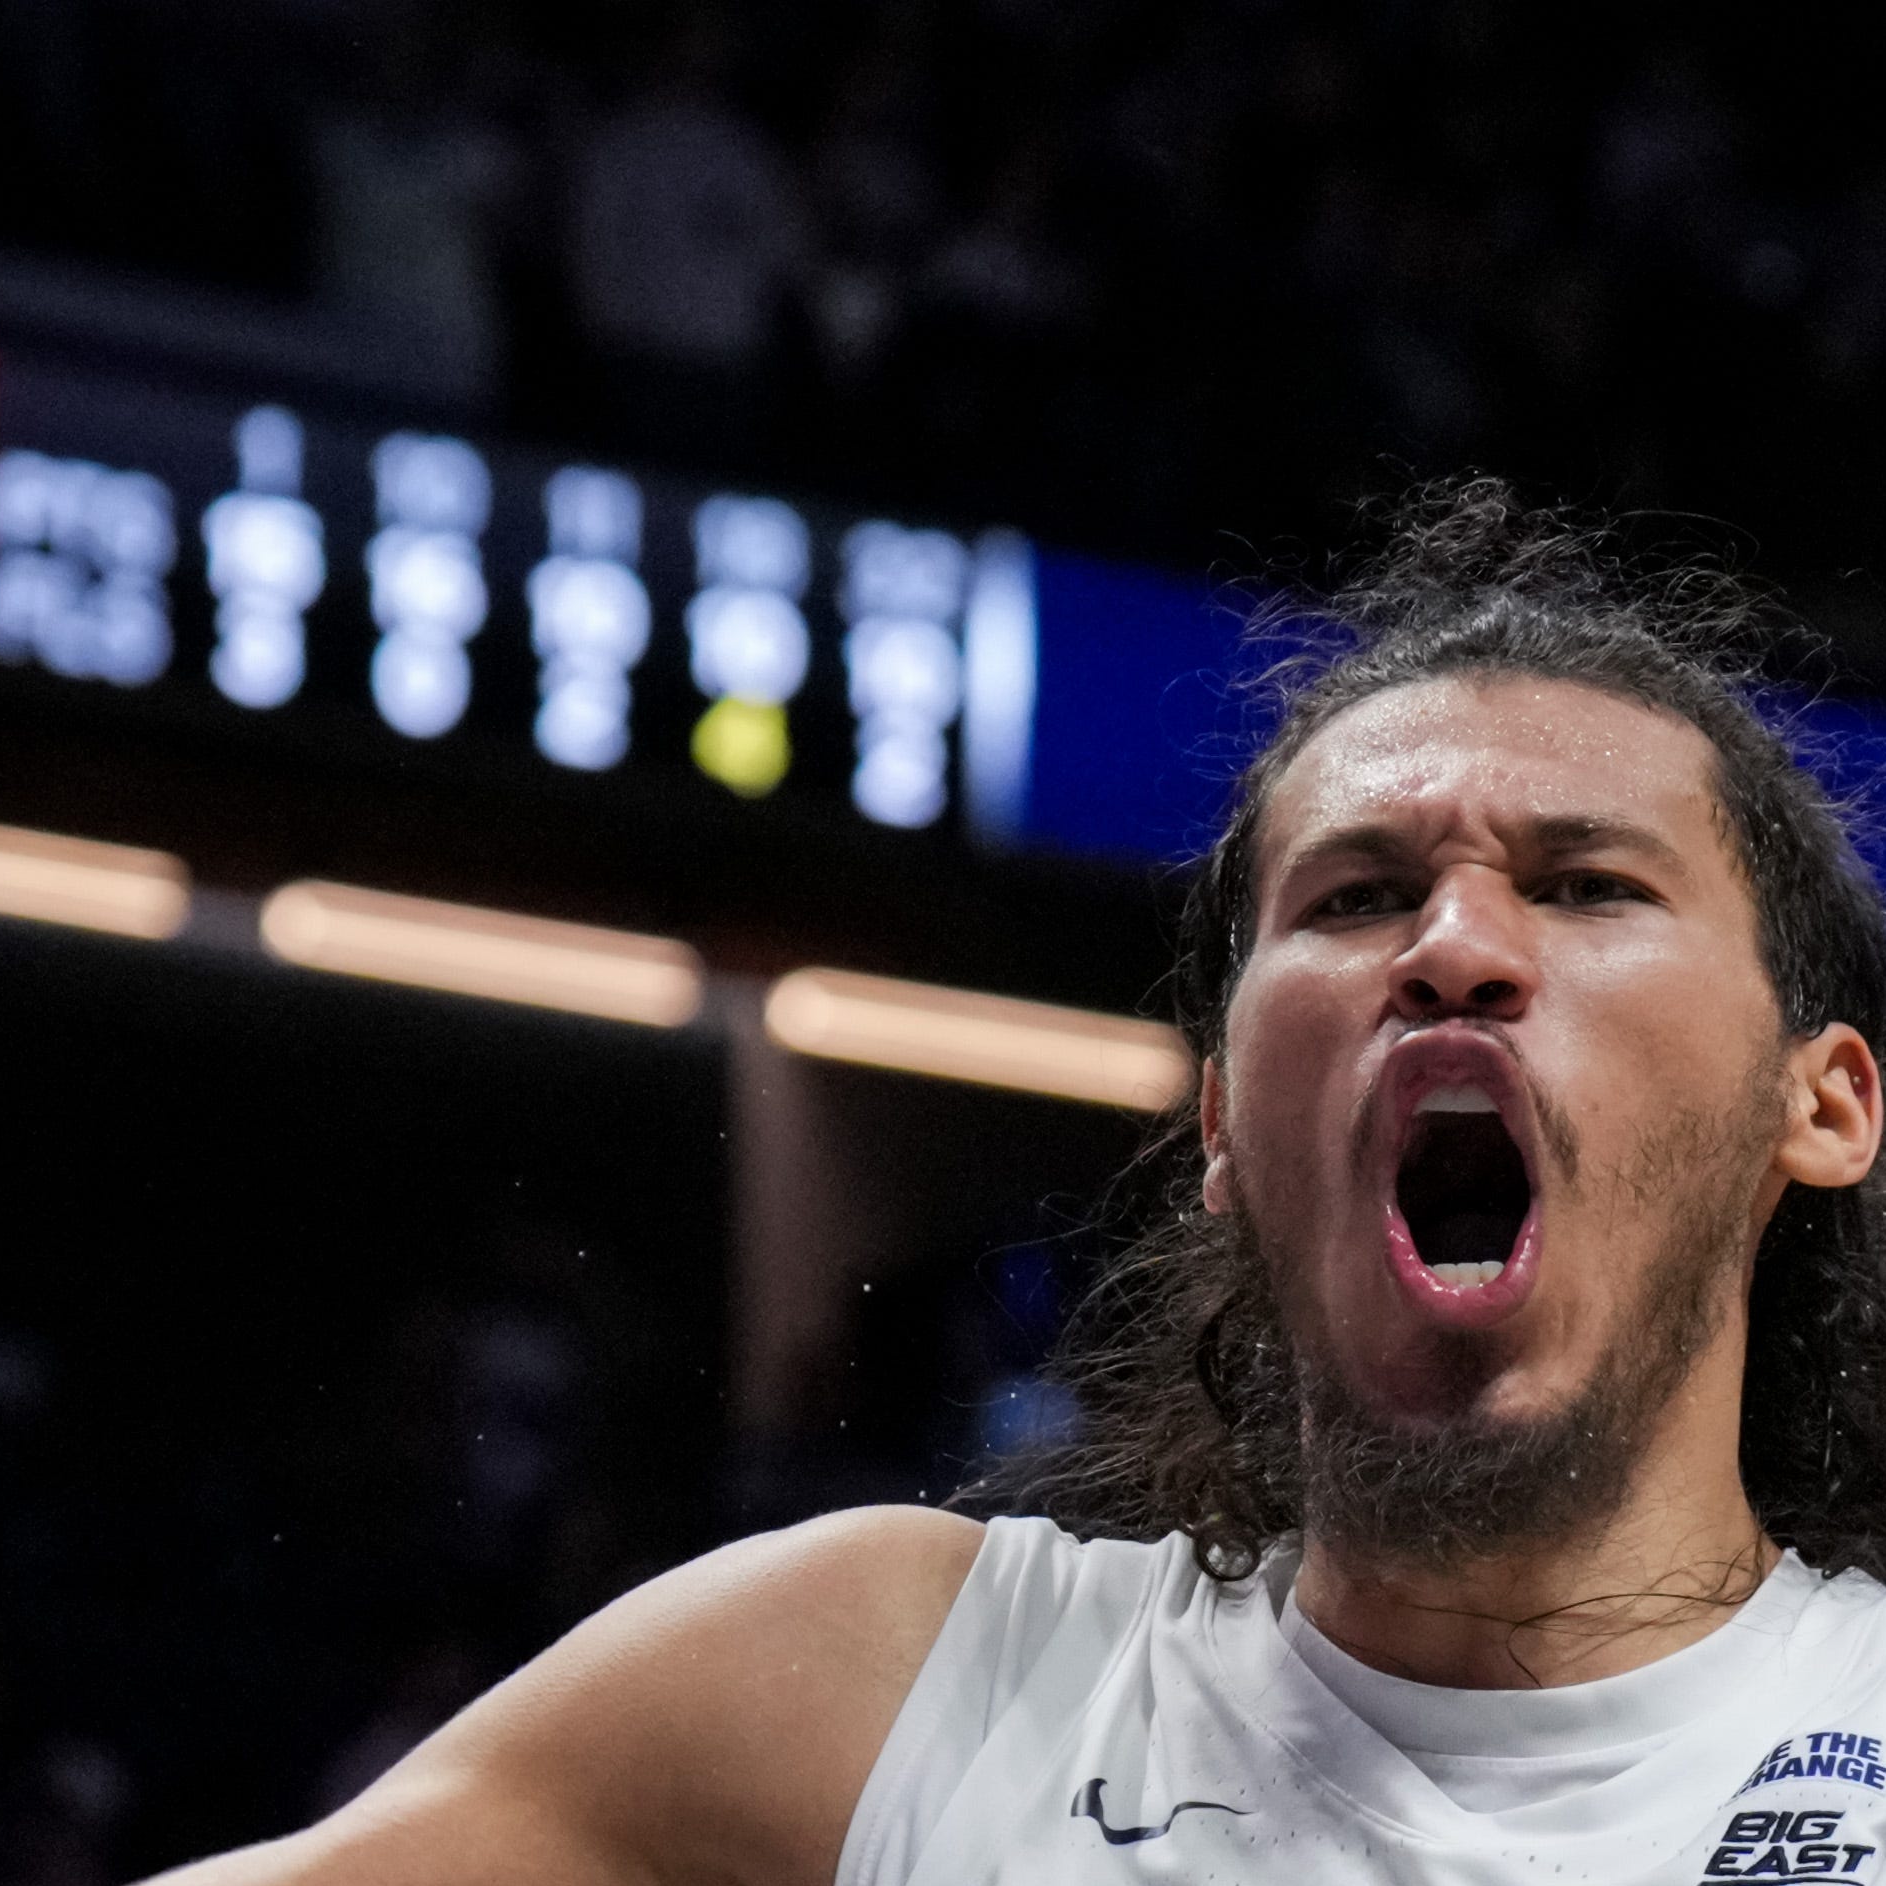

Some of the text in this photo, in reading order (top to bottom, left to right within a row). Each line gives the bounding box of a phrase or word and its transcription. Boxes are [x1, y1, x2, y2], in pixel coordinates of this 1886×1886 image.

[1806, 1731, 1883, 1762] THE
[1721, 1810, 1846, 1843] BIG
[1704, 1843, 1876, 1877] EAST
